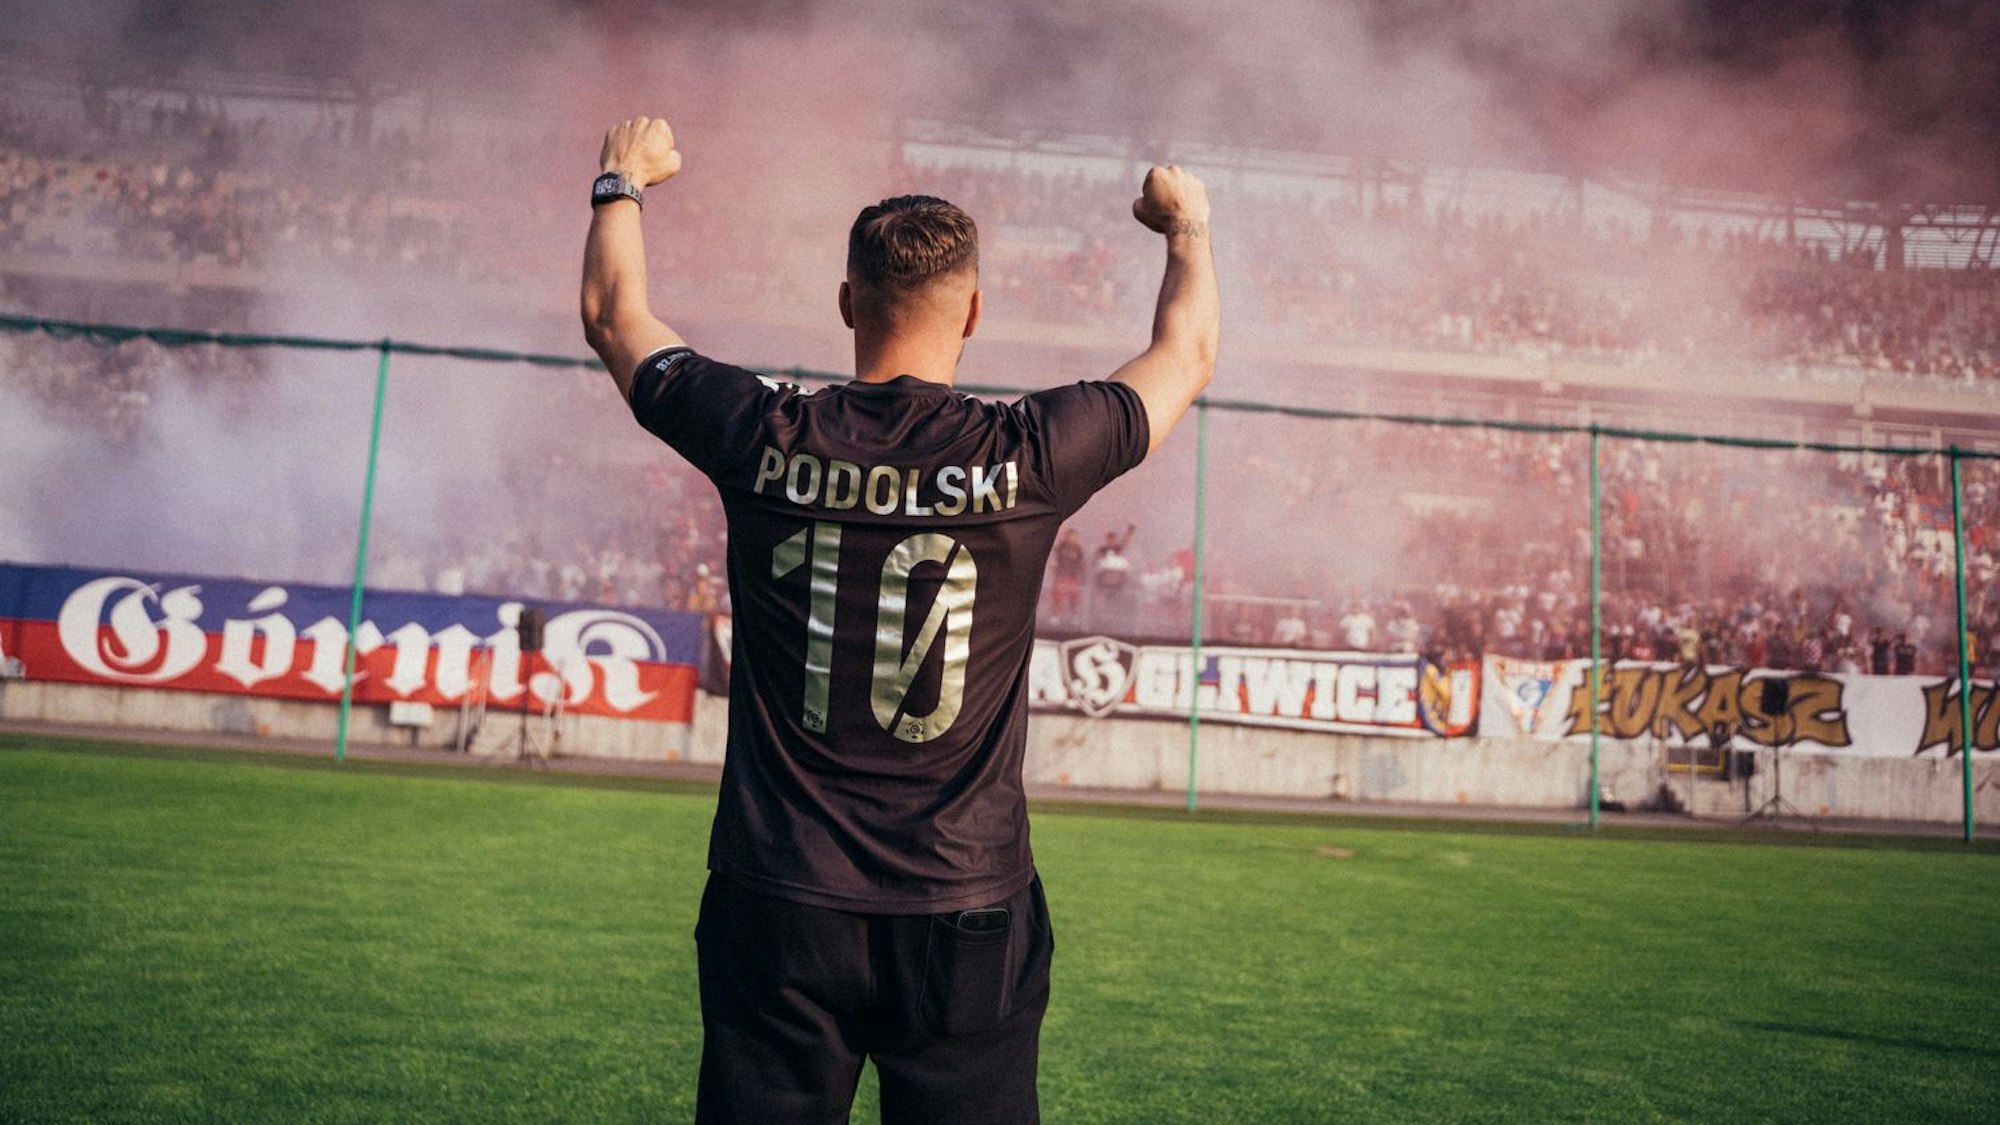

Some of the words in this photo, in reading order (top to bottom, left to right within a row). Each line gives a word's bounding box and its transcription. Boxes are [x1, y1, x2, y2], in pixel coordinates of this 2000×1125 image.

[753, 445, 1018, 517] PODOLSKI
[771, 521, 979, 744] 10
[1136, 651, 1418, 723] GLIWICE
